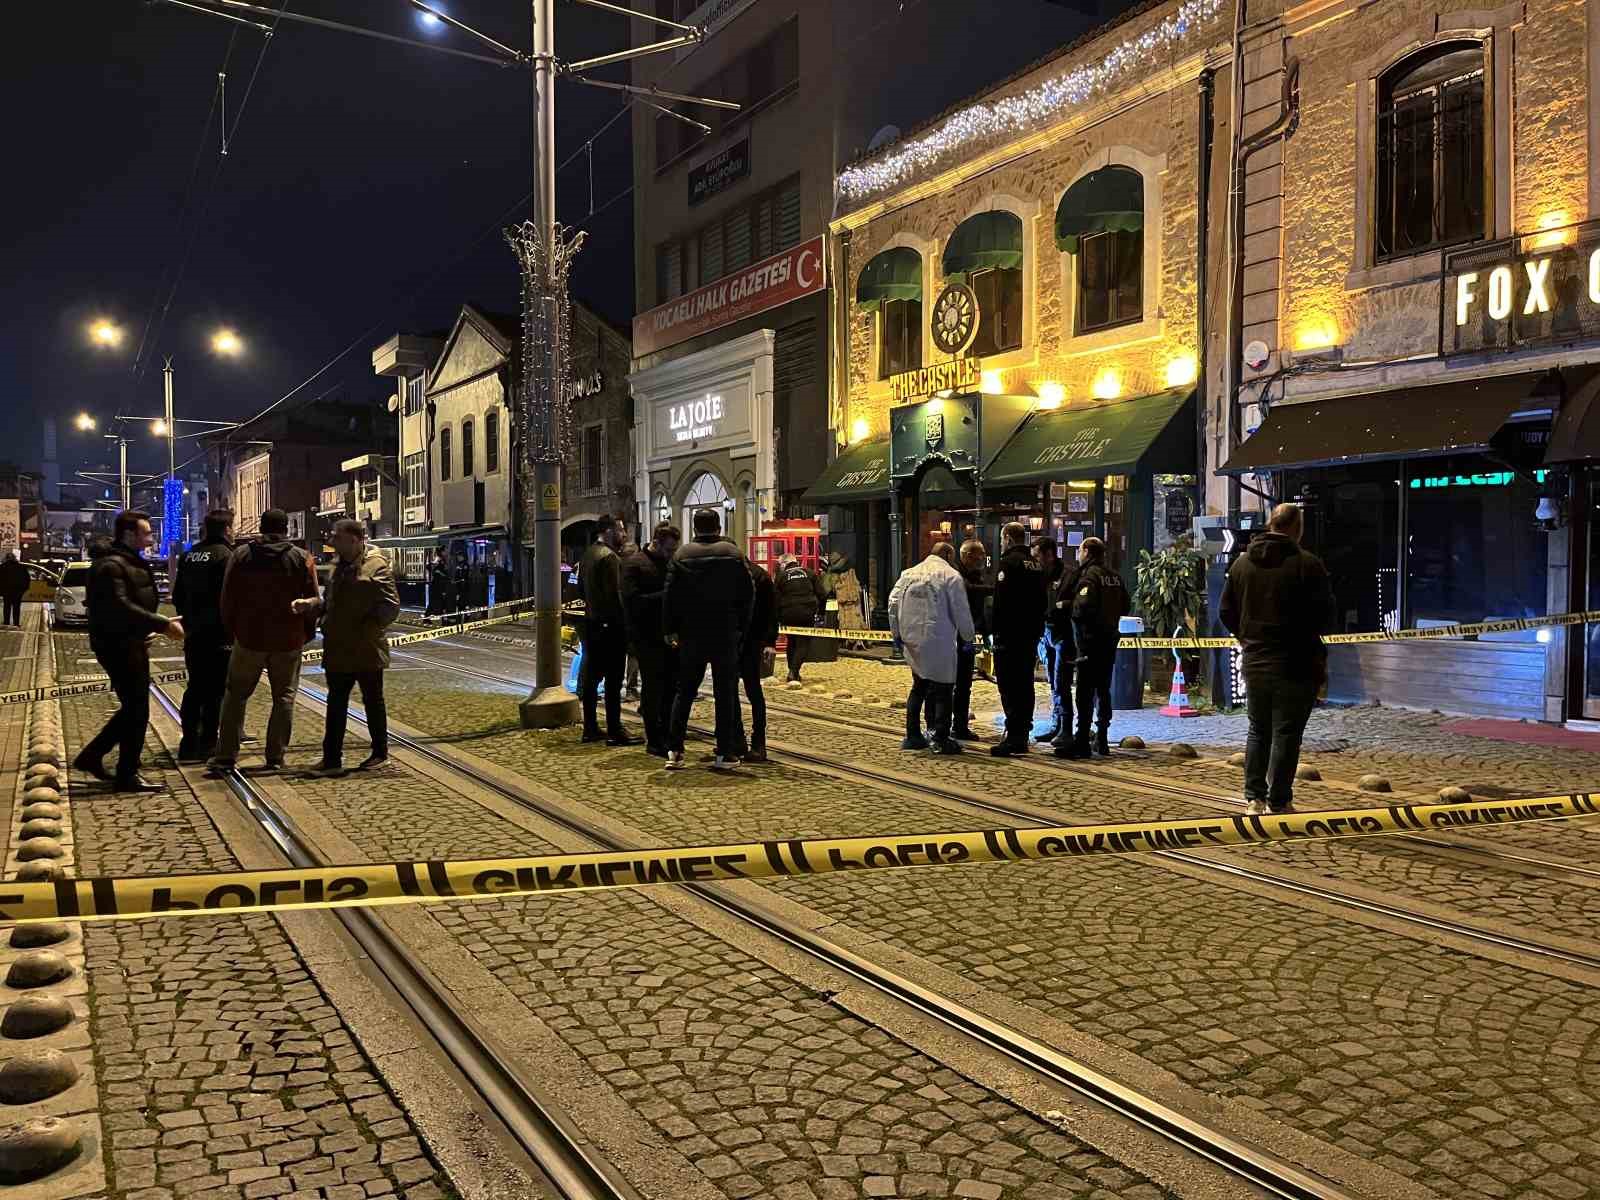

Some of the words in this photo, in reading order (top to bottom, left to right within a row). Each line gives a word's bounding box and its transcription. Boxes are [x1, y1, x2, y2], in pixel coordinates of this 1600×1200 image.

[696, 286, 728, 317] HALK
[731, 256, 792, 302] GAZETESİ
[1456, 258, 1552, 326] FOX
[890, 371, 917, 400] THE
[918, 357, 975, 398] CASTLE
[1034, 438, 1112, 465] CASTLE
[1, 691, 30, 704] YERİ
[50, 683, 108, 698] GİRİLMEZ
[158, 670, 186, 684] YERİ
